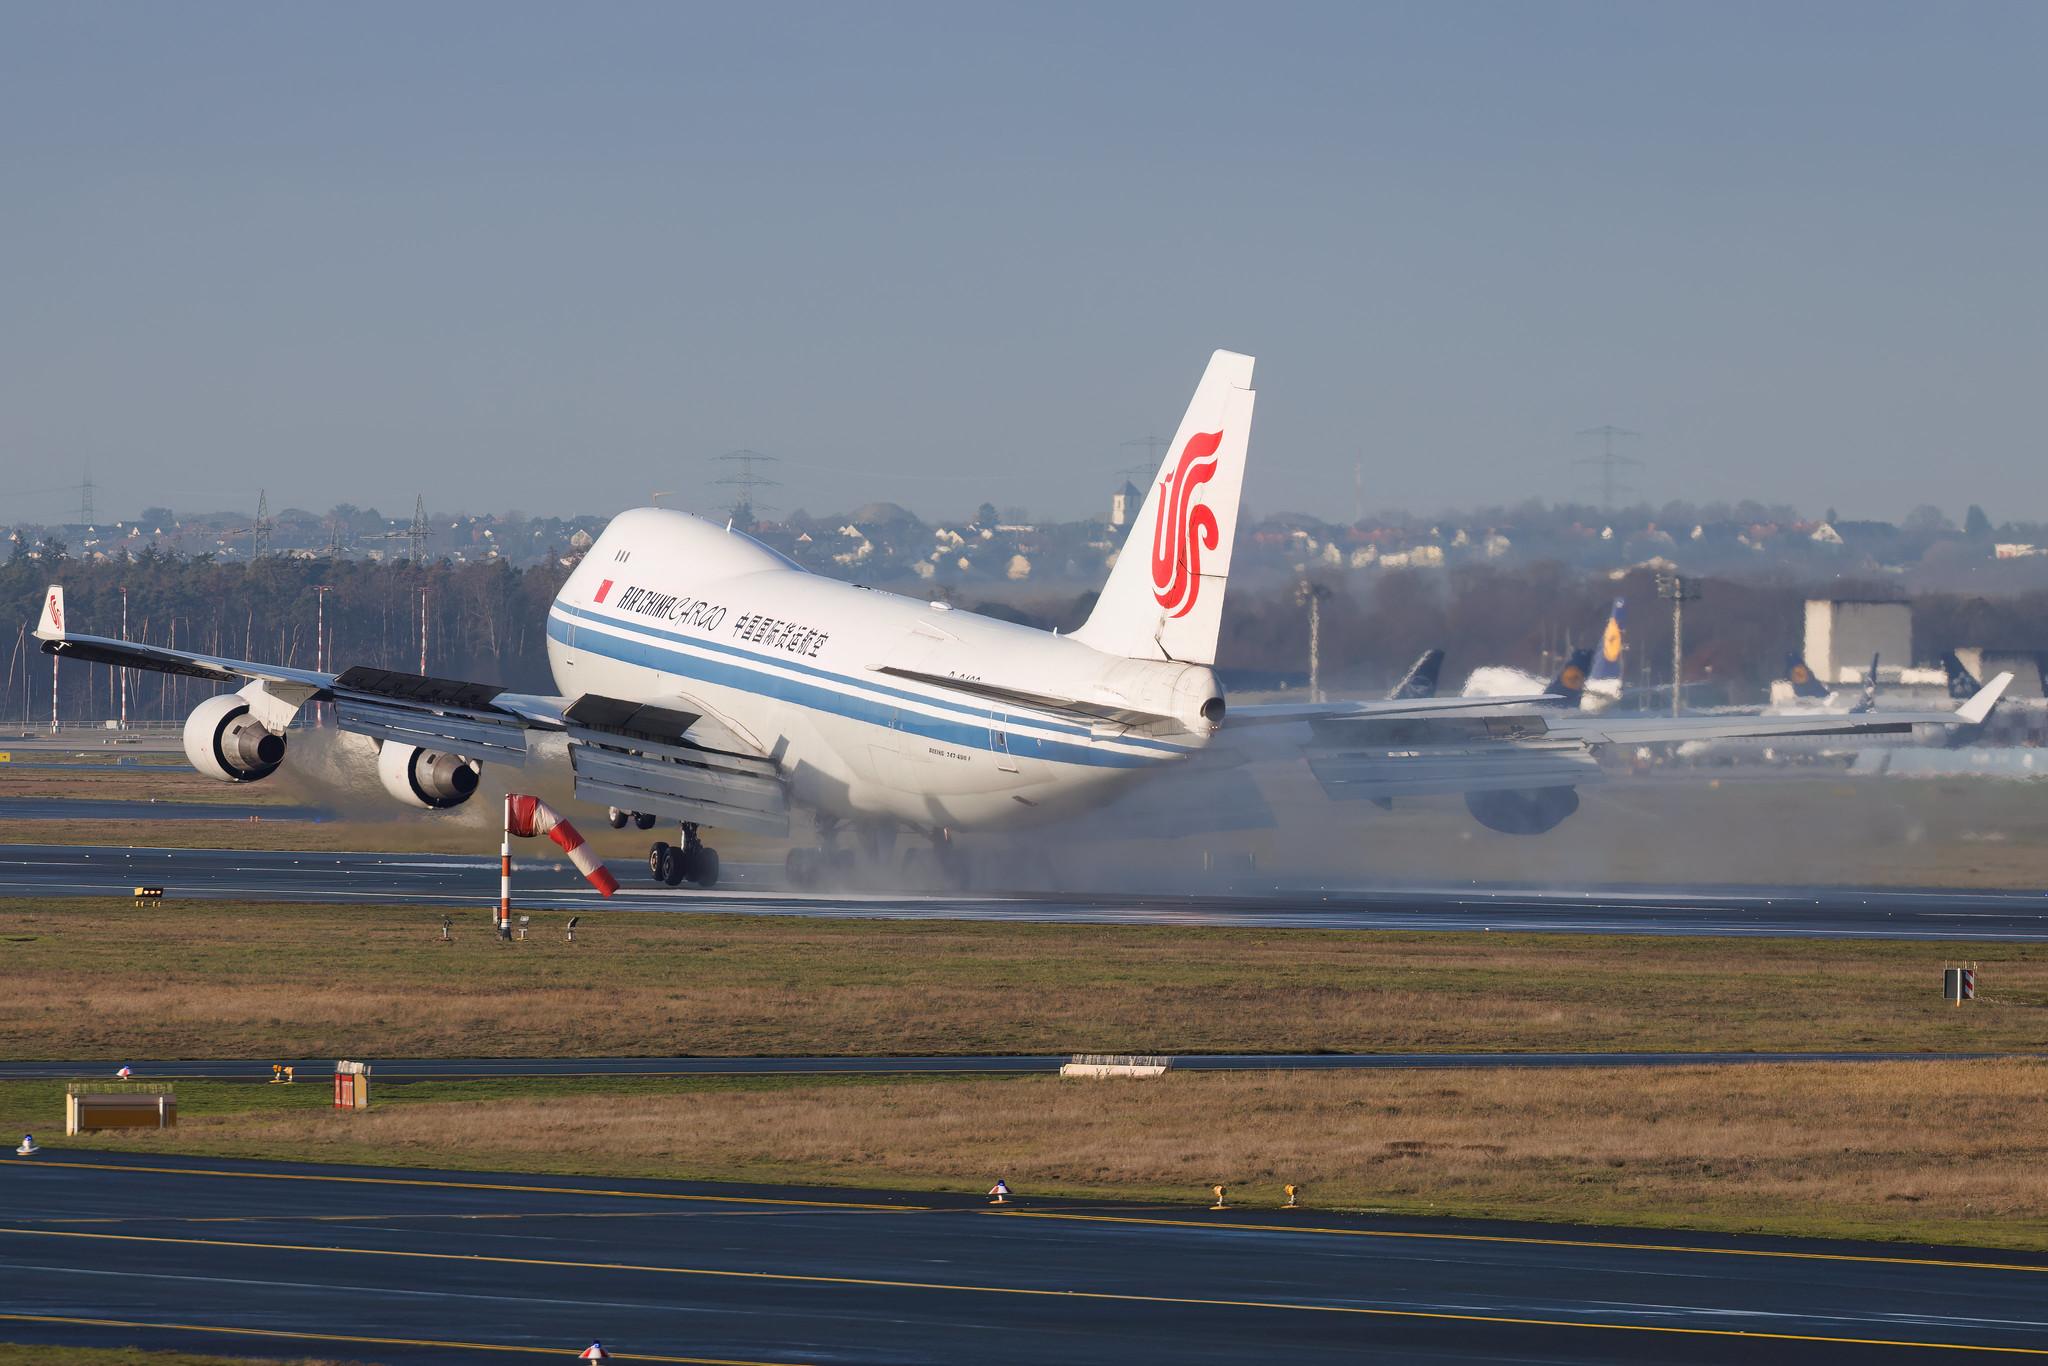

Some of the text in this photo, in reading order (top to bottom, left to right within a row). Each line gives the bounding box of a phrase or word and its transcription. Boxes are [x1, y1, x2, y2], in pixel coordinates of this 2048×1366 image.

[617, 586, 727, 631] AIR CHINA CARGO
[733, 611, 829, 658] 中国国际货运航空
